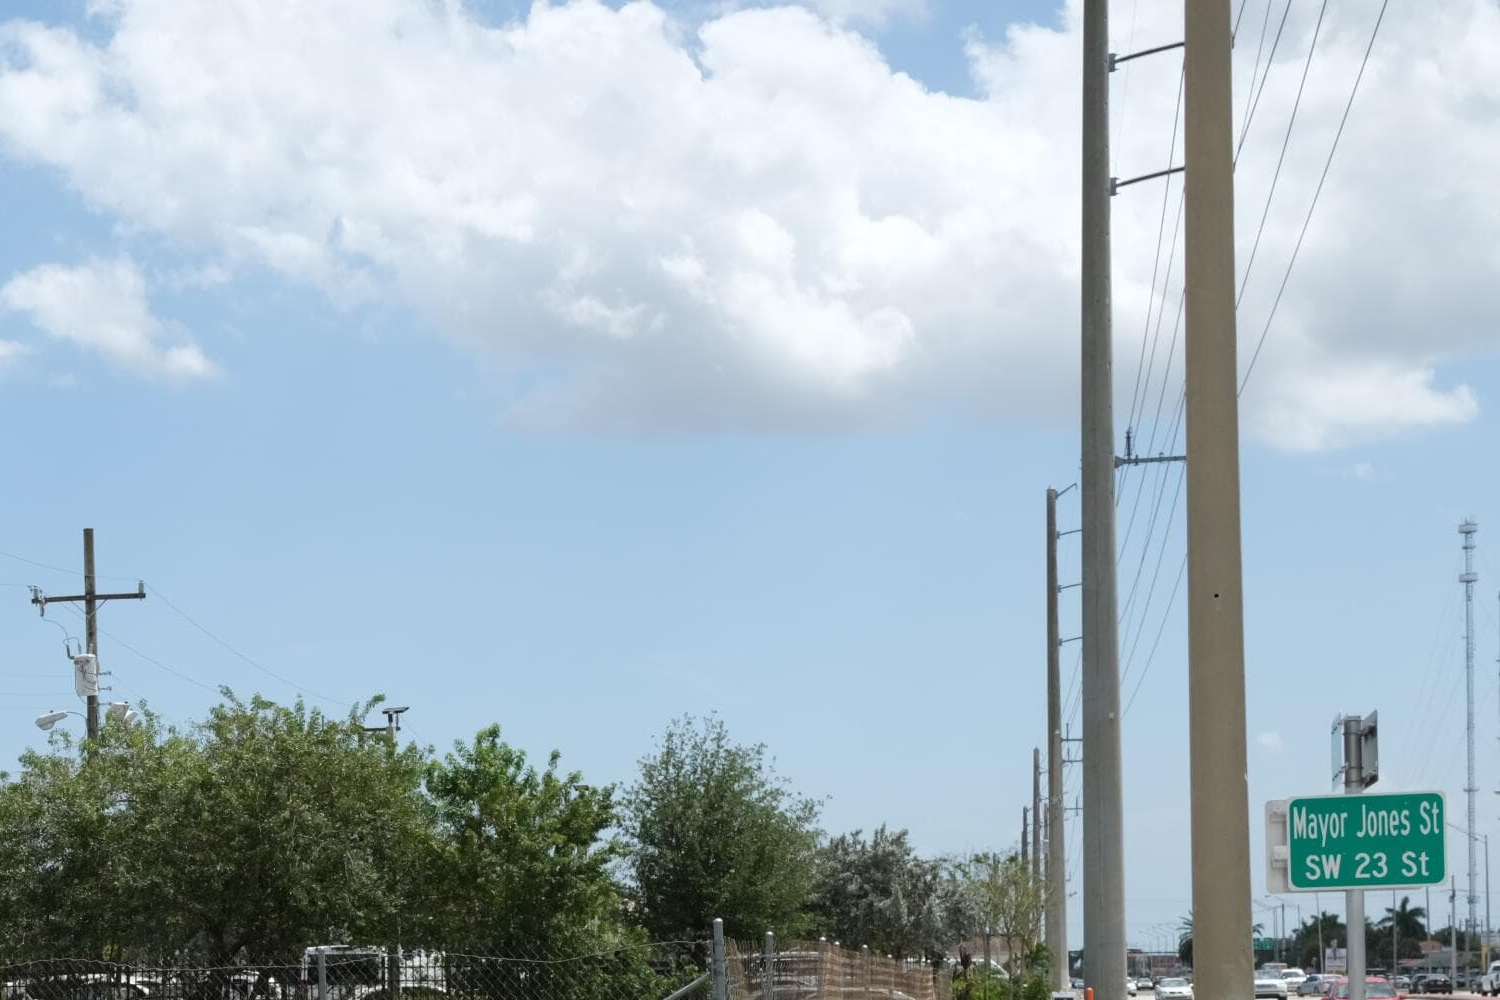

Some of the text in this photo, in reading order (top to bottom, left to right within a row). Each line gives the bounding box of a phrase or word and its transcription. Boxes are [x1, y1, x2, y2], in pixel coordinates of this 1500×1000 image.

[1293, 801, 1440, 847] Mayor Jones St
[1305, 850, 1430, 880] SW 23 St
